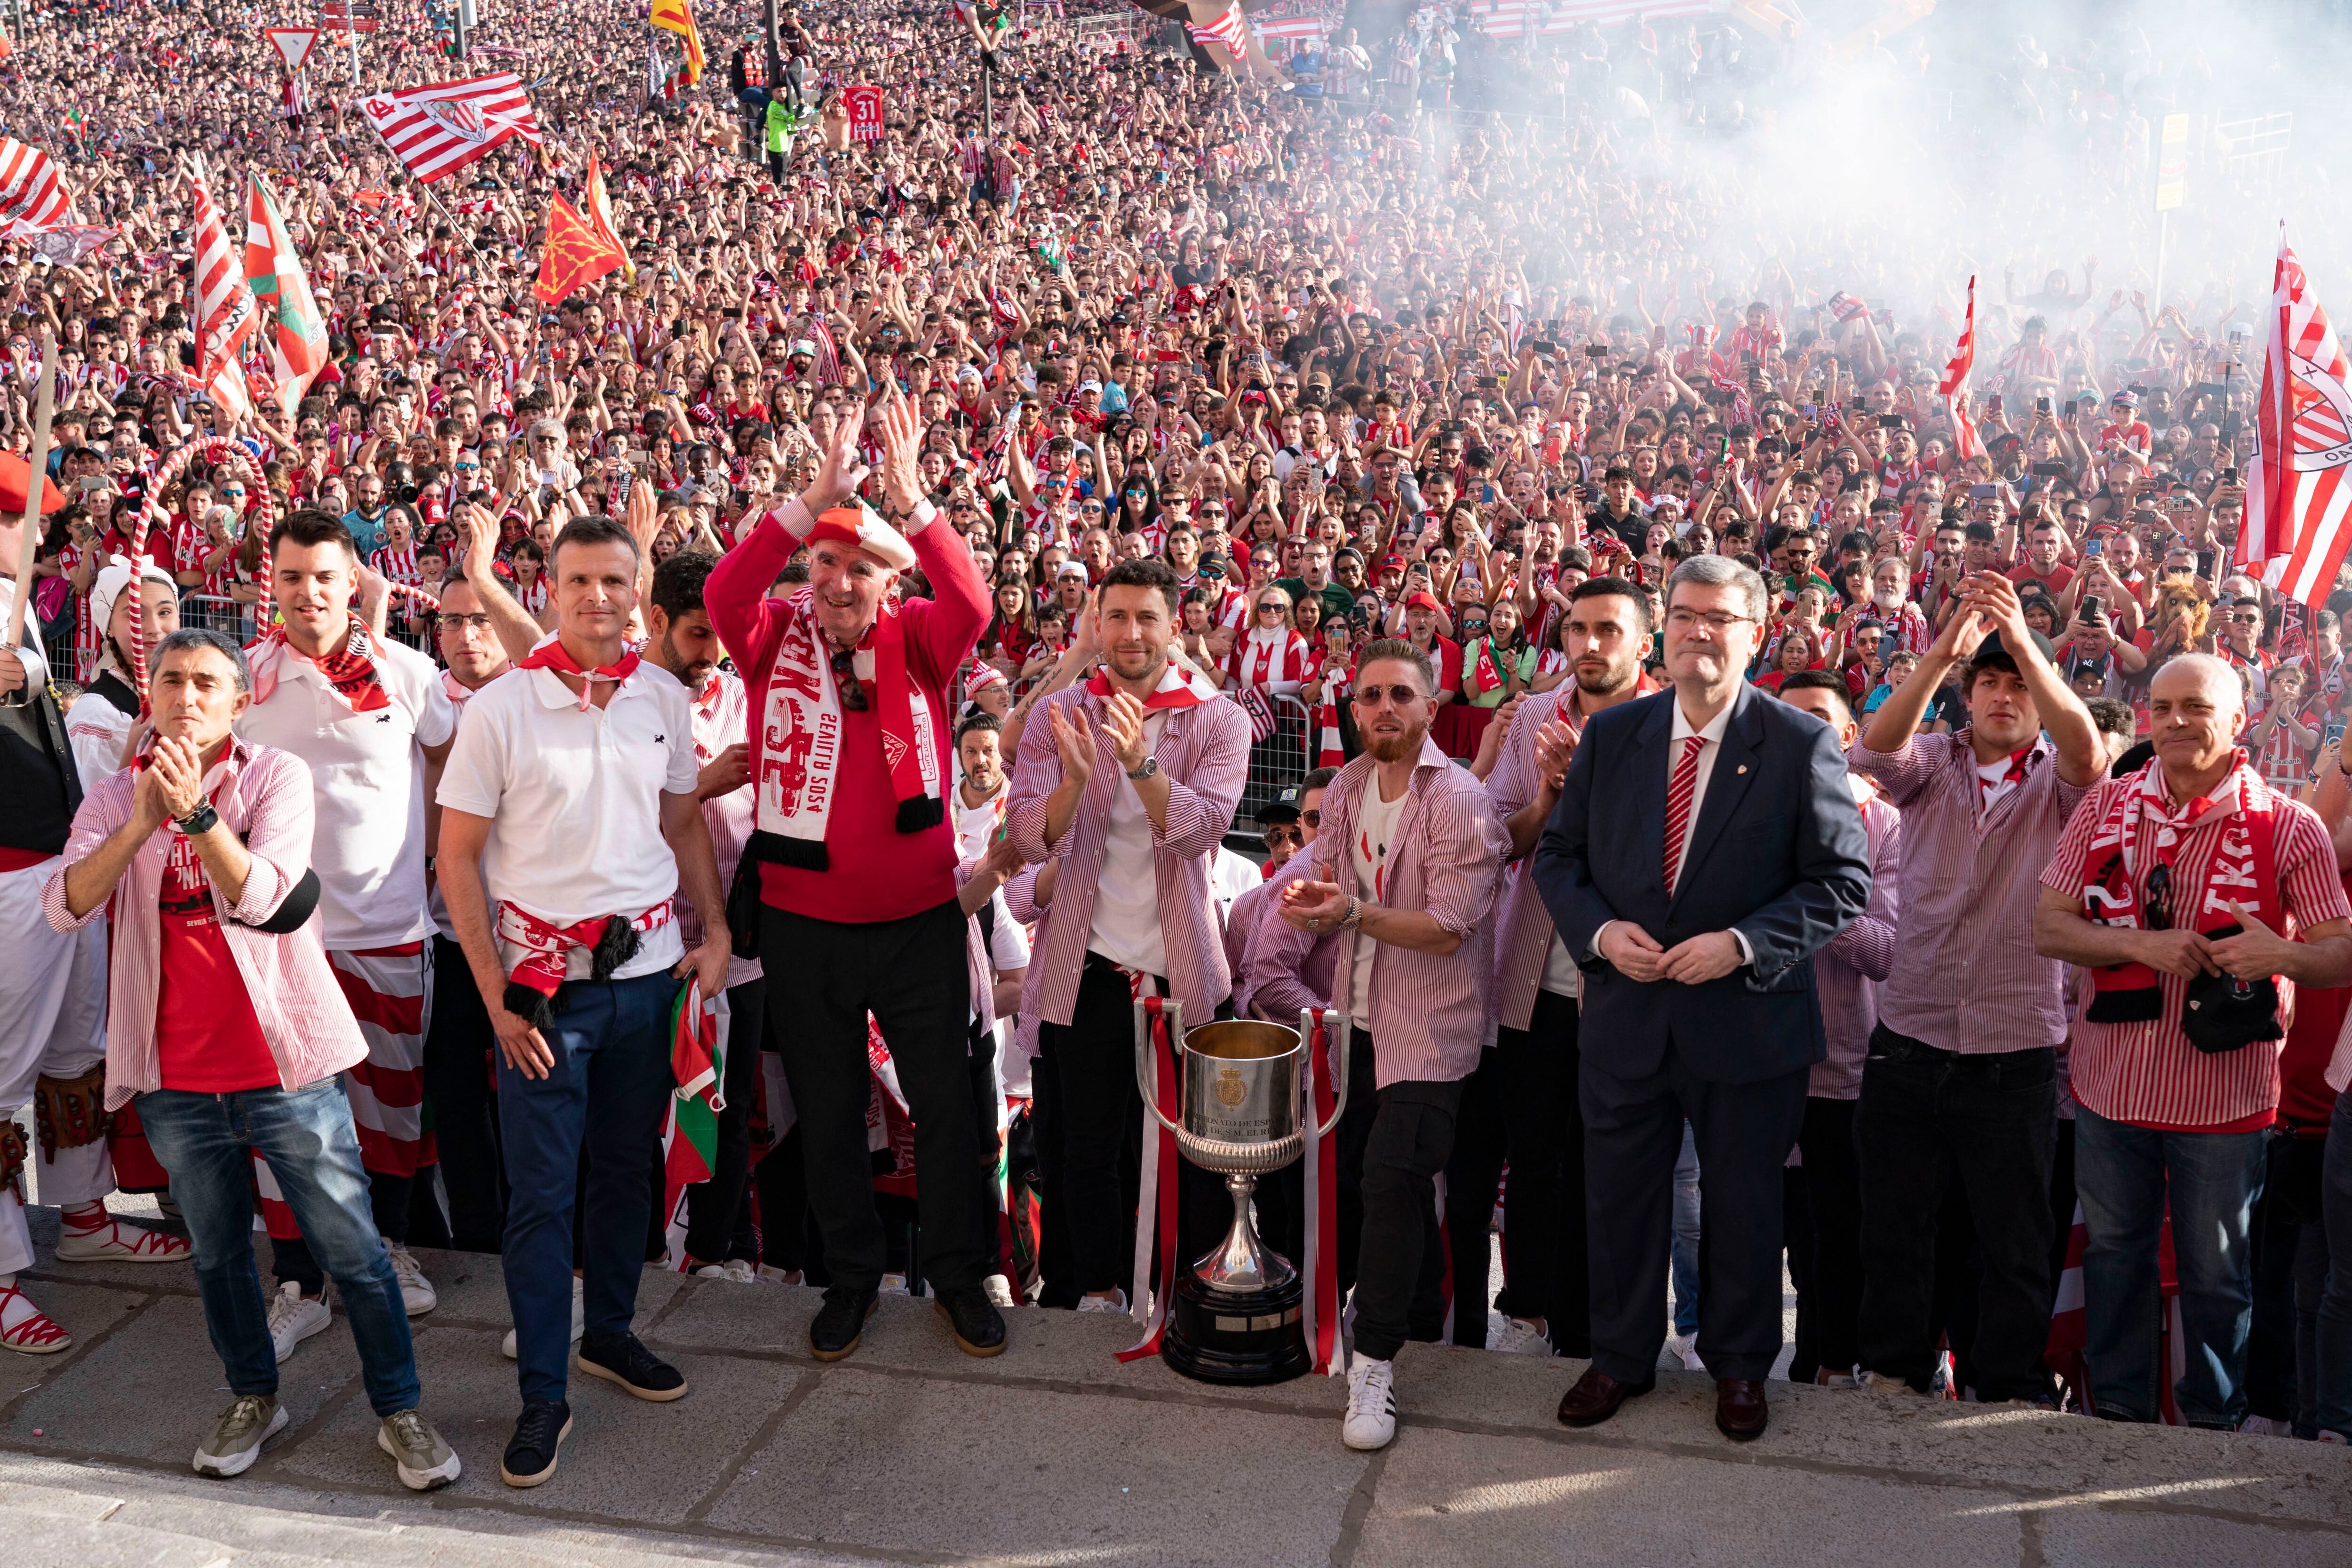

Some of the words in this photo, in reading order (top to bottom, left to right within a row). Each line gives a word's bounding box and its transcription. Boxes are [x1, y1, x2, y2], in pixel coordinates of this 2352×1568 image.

[857, 100, 875, 120] 31
[461, 119, 482, 141] BILBAO
[2082, 659, 2094, 668] NY
[1040, 678, 1051, 692] walk
[1051, 667, 1063, 680] alone
[883, 735, 905, 765] BILBAO
[2265, 752, 2301, 764] Kutxabank
